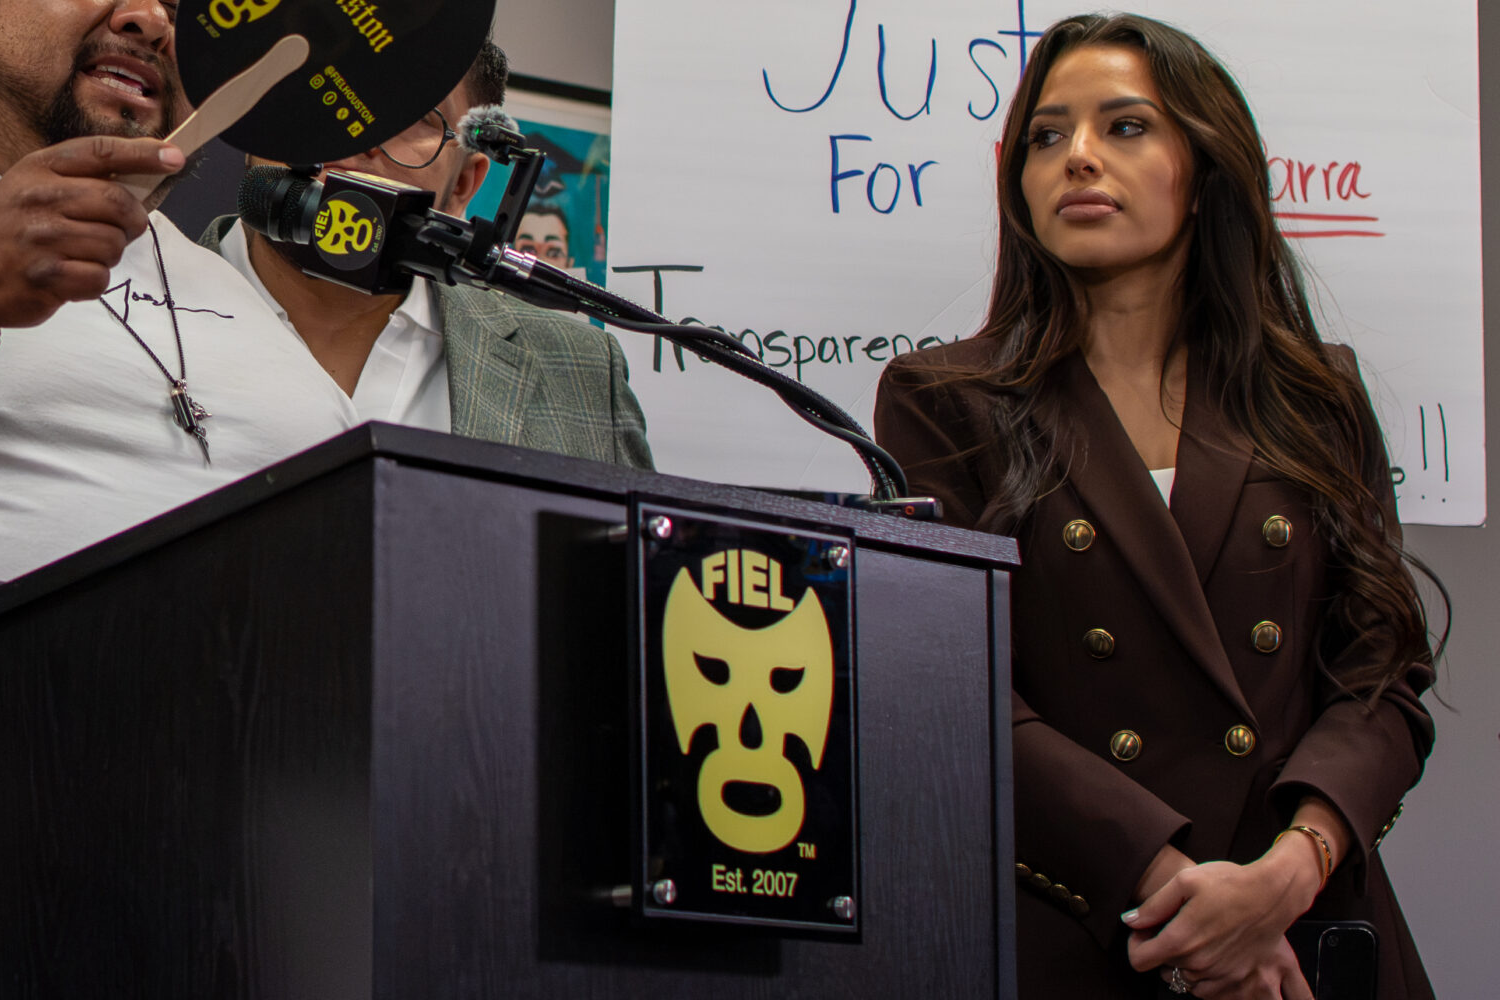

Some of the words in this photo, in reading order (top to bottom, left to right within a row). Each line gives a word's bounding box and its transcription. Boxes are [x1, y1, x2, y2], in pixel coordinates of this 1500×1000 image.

[829, 134, 940, 214] For
[1262, 137, 1372, 203] arra
[315, 208, 330, 238] FIEL
[702, 548, 795, 613] FIEL
[797, 842, 817, 859] TM
[711, 864, 748, 893] Est.
[752, 868, 799, 898] 2007
